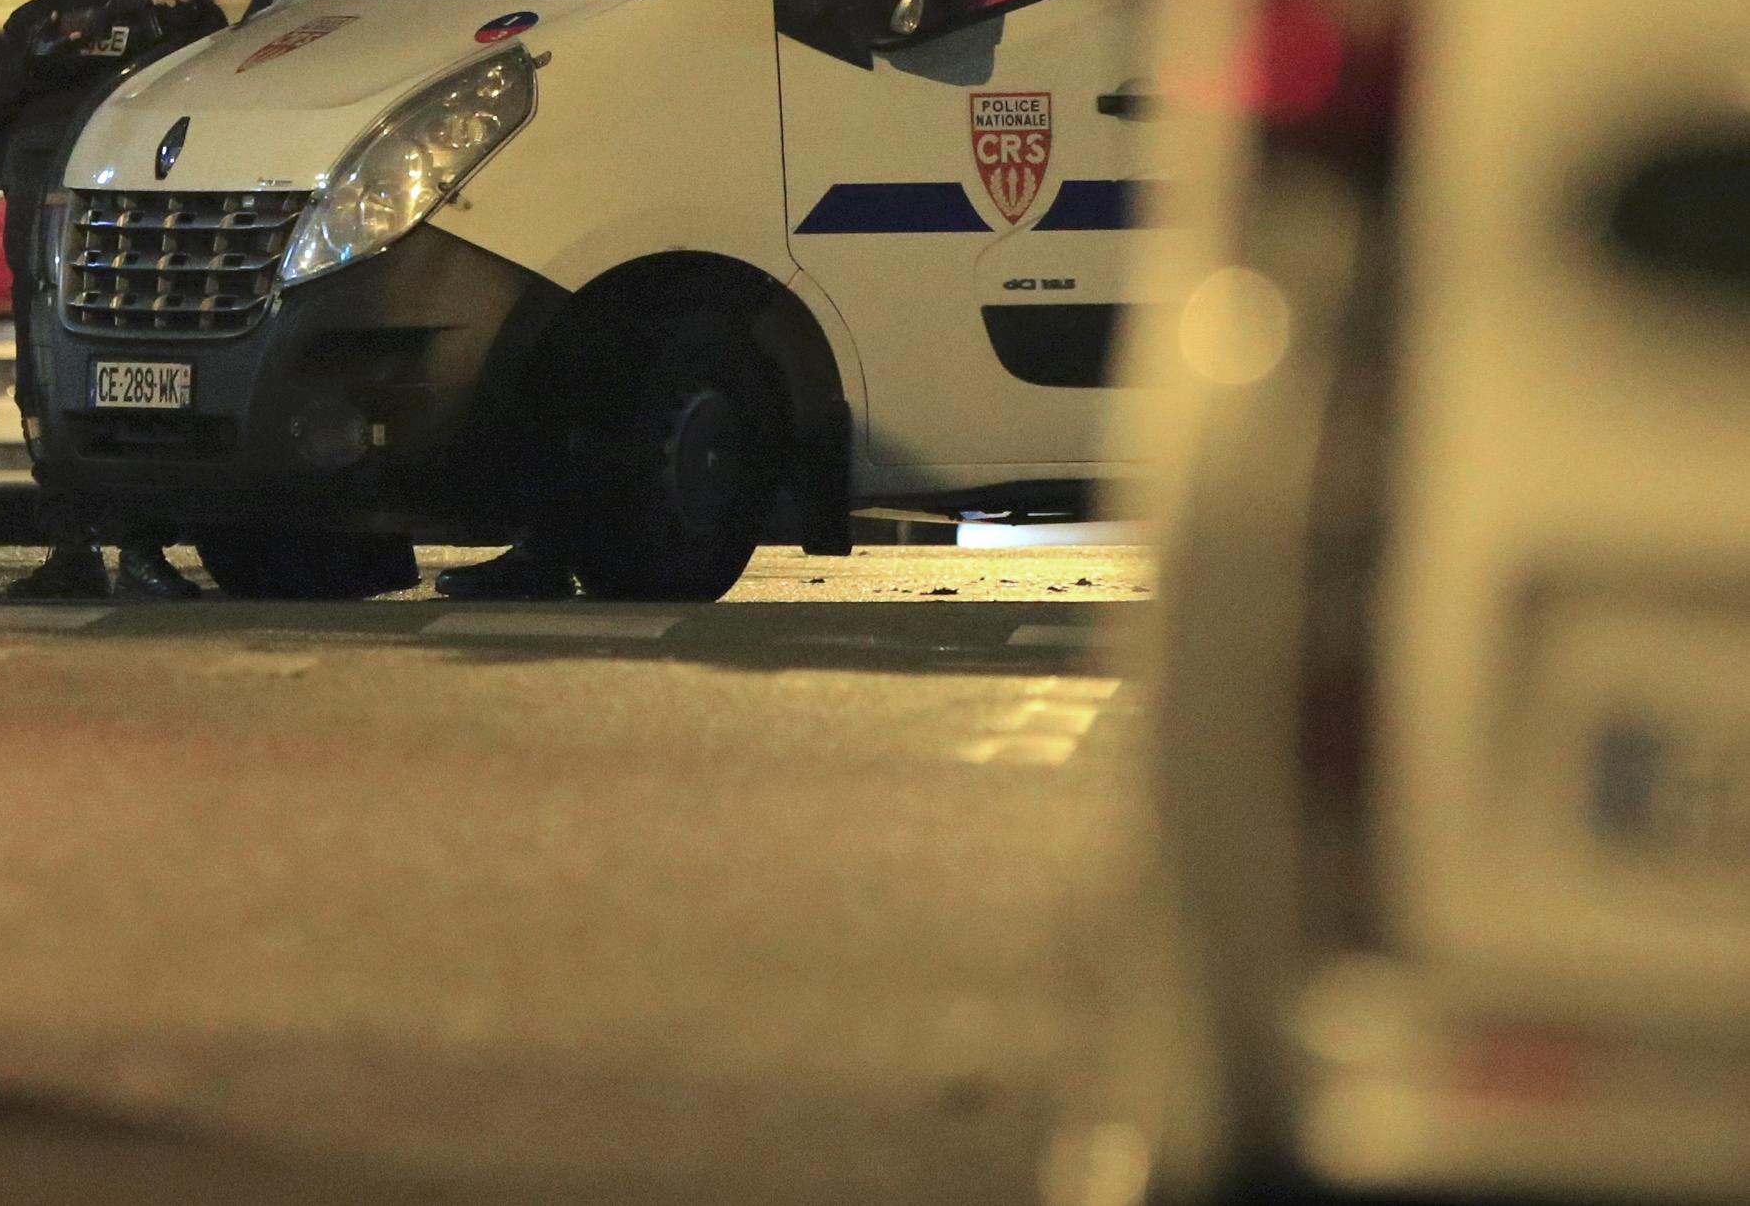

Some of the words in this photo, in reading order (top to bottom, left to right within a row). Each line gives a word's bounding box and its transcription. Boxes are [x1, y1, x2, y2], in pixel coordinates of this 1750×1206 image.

[982, 100, 1040, 112] POLICE
[976, 114, 1046, 127] NATIONALE
[977, 134, 1046, 164] CRS
